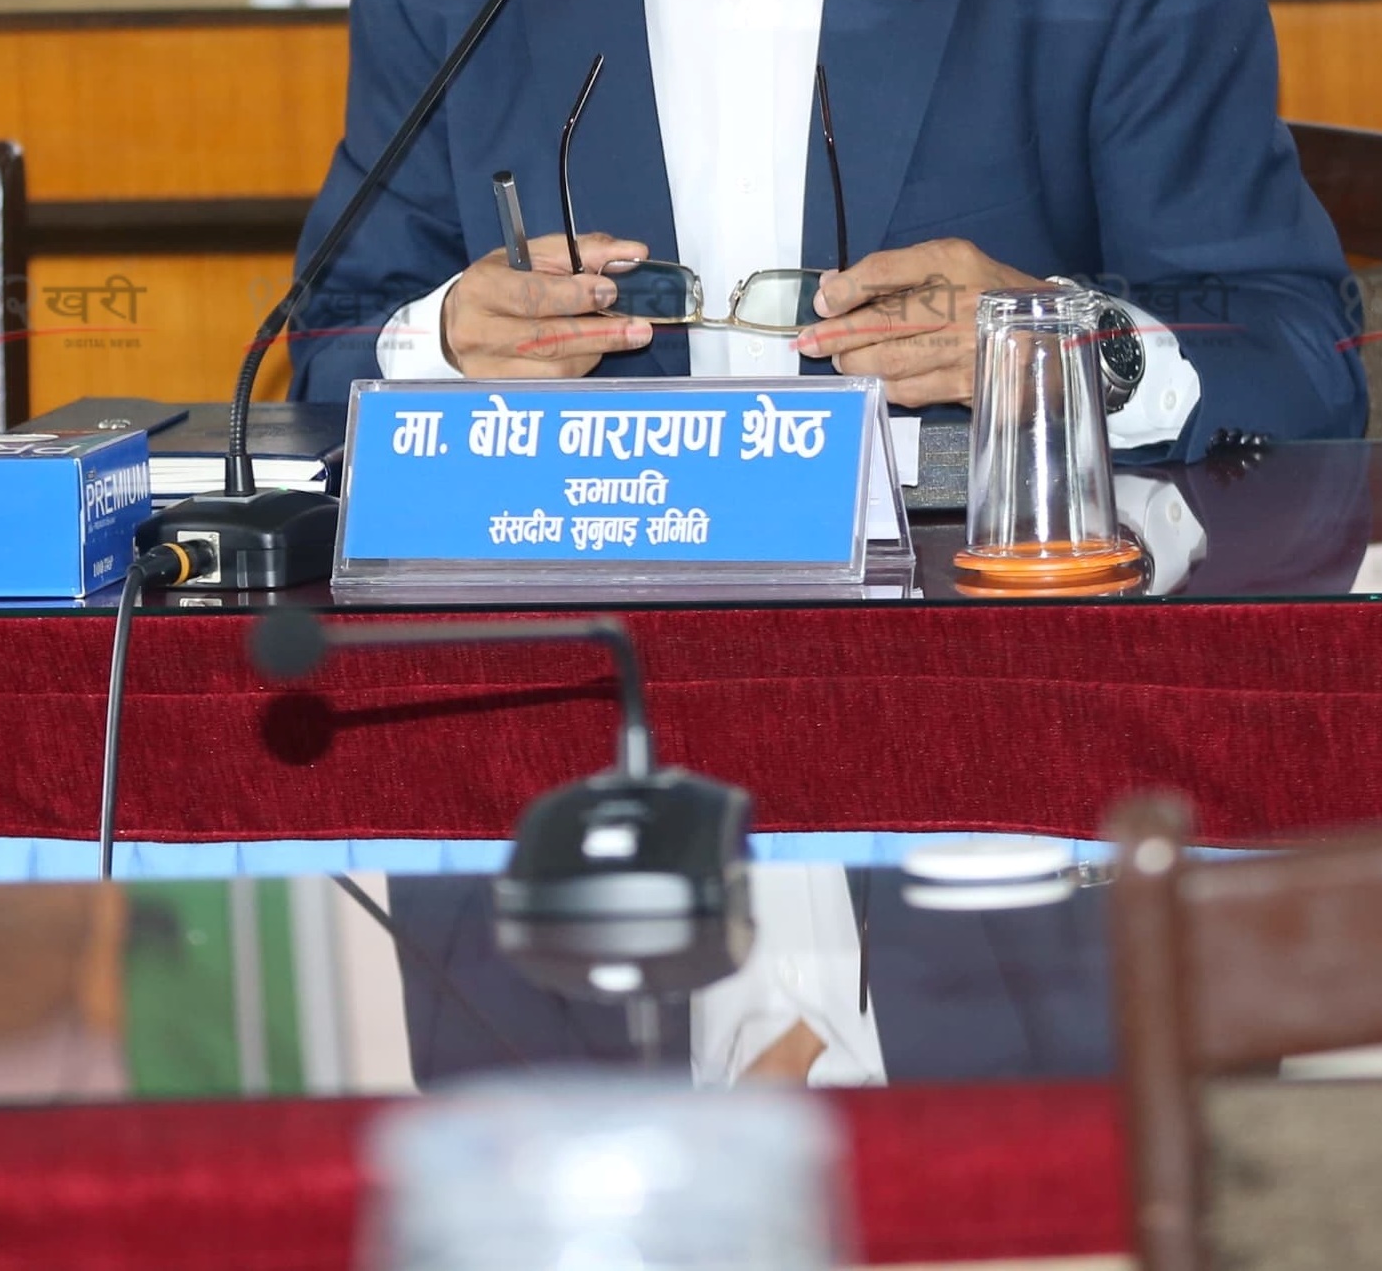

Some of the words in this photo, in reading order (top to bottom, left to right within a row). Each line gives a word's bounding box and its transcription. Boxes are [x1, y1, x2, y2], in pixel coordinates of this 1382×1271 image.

[393, 410, 448, 457] मा.
[468, 395, 544, 458] बोध
[560, 410, 725, 460] नारायण
[739, 394, 832, 460] श्रेष्ठ
[85, 461, 148, 522] PREMIUM
[564, 469, 669, 506] सभापति
[488, 509, 563, 545] संसदीय
[570, 514, 638, 551] सुनुवाइ
[645, 509, 711, 545] समिति
